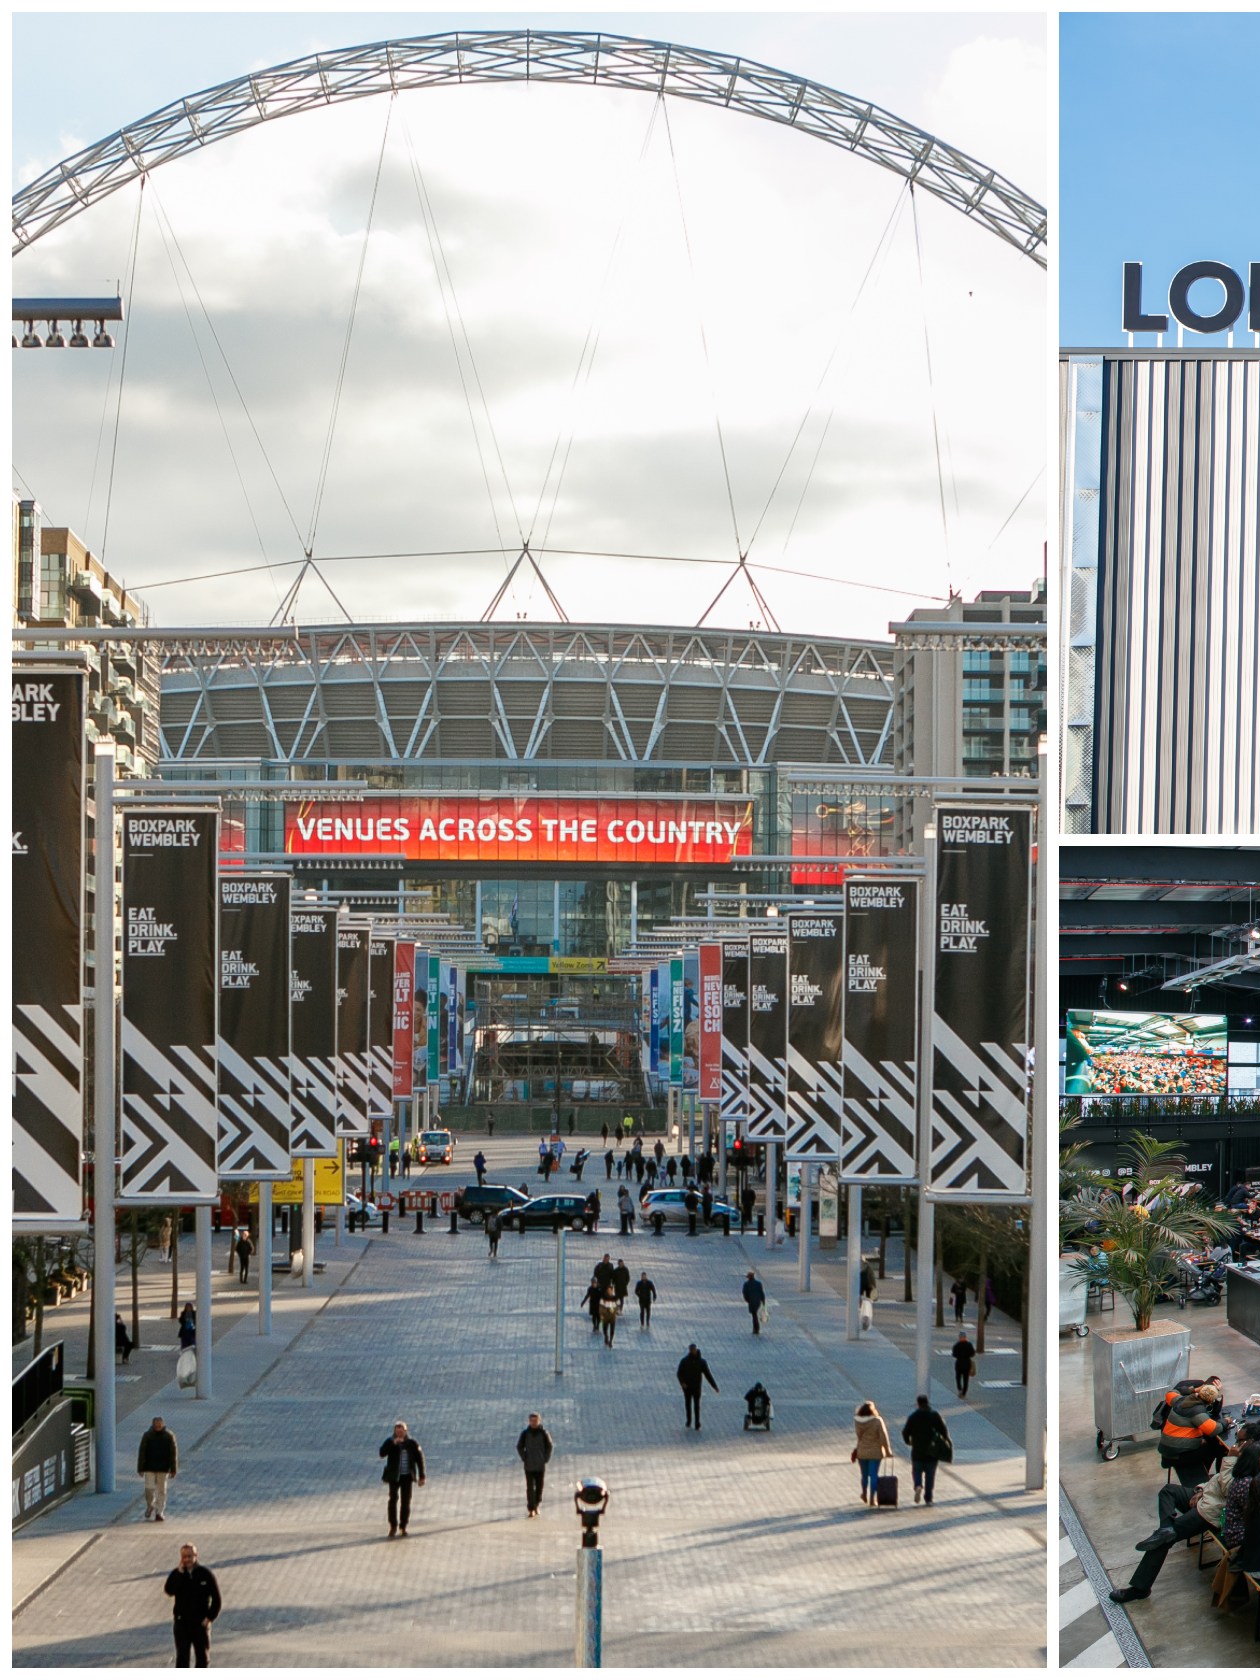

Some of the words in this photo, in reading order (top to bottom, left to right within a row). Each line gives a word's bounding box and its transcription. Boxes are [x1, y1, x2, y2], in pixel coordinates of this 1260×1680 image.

[128, 820, 196, 832] BOXPARK
[942, 816, 1010, 830] BOXPARK
[296, 817, 410, 841] VENUES
[418, 818, 533, 842] ACROSS
[542, 819, 598, 842] THE
[607, 820, 742, 844] COUNTRY
[129, 834, 200, 847] WEMBLEY
[943, 830, 1014, 844] WEMBLEY
[222, 882, 274, 892] BOXPARK
[850, 887, 901, 897] BOXPARK
[222, 893, 277, 904] WEMBLEY
[850, 898, 905, 908] WEMBLEY
[128, 908, 156, 920] EAT.
[941, 904, 968, 917] EAT.
[290, 916, 324, 924] XPARK
[792, 920, 834, 928] BOXPARK
[128, 924, 178, 937] DRINK.
[792, 928, 837, 937] WEMBLEY
[941, 920, 990, 934] DRINK.
[128, 940, 165, 952] PLAY.
[941, 936, 977, 949] PLAY.
[222, 950, 243, 961] EAT.
[849, 954, 870, 965] EAT.
[222, 963, 260, 973] DRINK.
[849, 967, 886, 977] DRINK.
[222, 976, 250, 986] PLAY.
[792, 975, 809, 984] EAT.
[849, 980, 877, 990] PLAY.
[792, 985, 822, 994] DRINK.
[792, 995, 815, 1004] PLAY.
